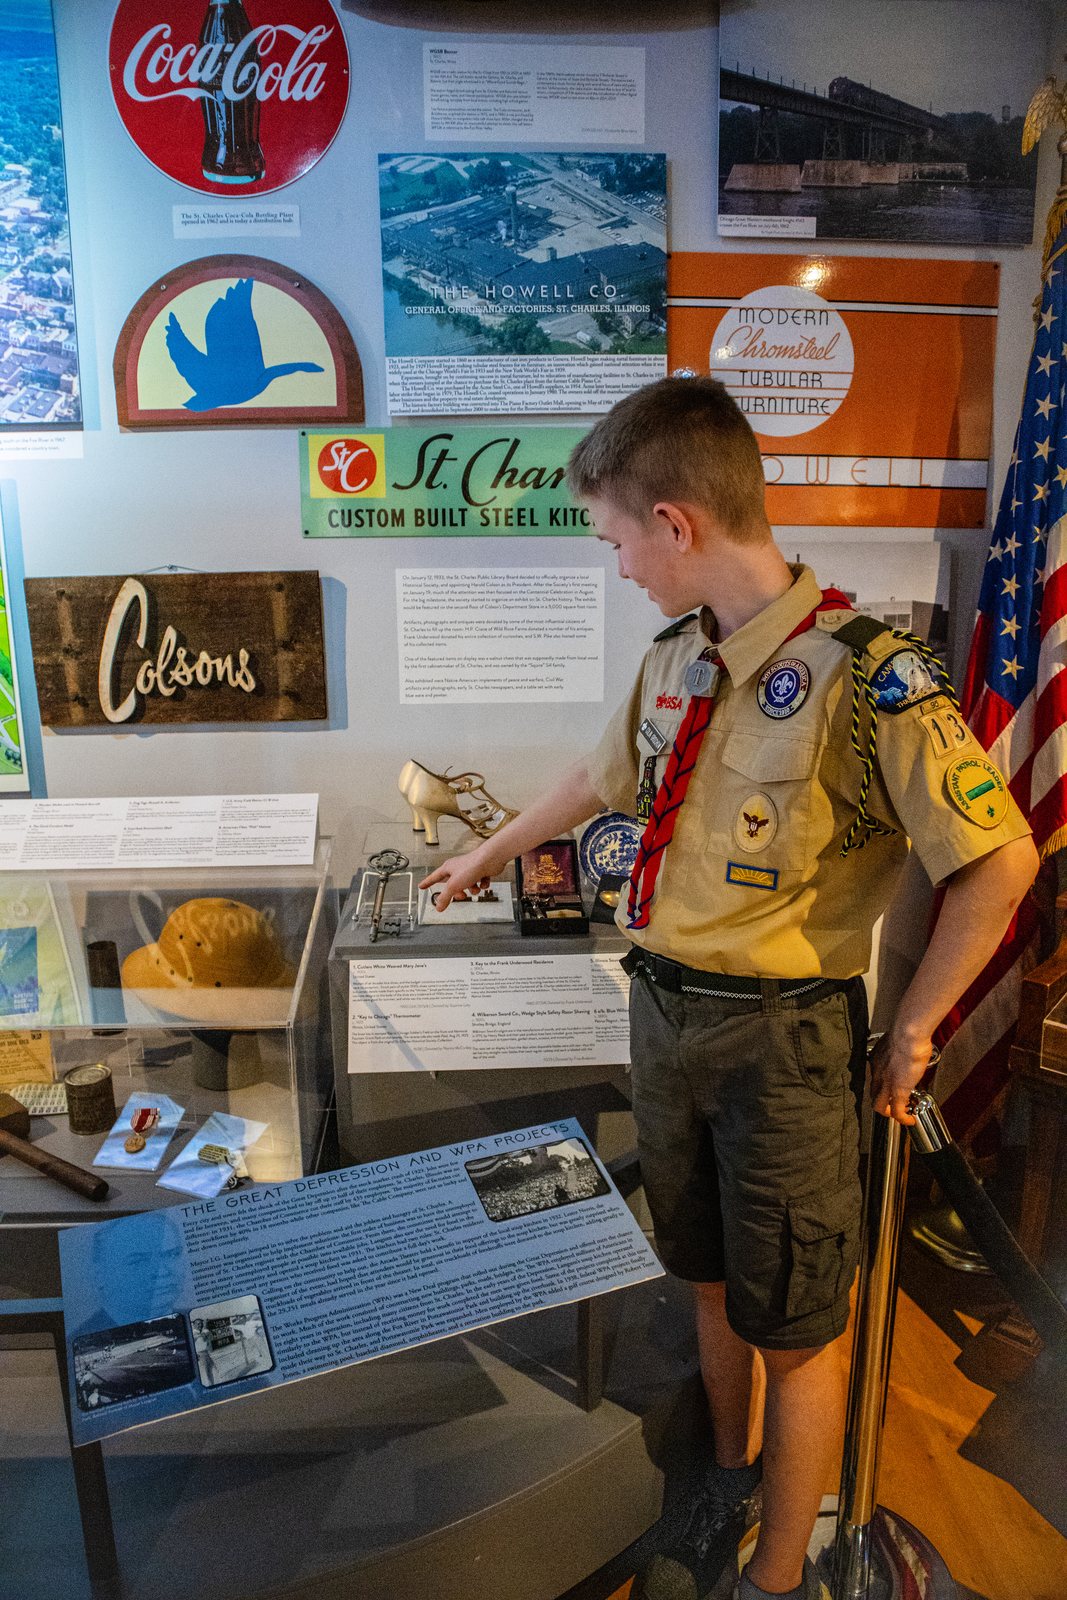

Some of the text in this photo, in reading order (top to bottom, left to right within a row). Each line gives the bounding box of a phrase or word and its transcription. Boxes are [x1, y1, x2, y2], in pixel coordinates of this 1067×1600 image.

[123, 24, 335, 102] Coca-Cola
[431, 285, 624, 299] THE HOWELL CO.
[405, 306, 446, 314] GENERAL
[738, 308, 829, 326] MODERN
[726, 325, 840, 360] Chromsteel
[740, 370, 822, 388] TUBULAR
[392, 434, 566, 507] St. Char
[762, 456, 930, 486] OWELL
[328, 508, 596, 529] CUSTOM BUILT STEEL KITC
[98, 576, 256, 723] Colsons
[664, 696, 682, 710] BSA
[952, 760, 1003, 810] ASSISTANT PATROL LEADER
[181, 1122, 569, 1217] THE GREAT DEPRESSION AND WPA PROJECTS
[189, 1259, 210, 1268] Mayor
[328, 1300, 371, 1316] Administration
[371, 1295, 392, 1305] (WPA)
[403, 1319, 419, 1327] River
